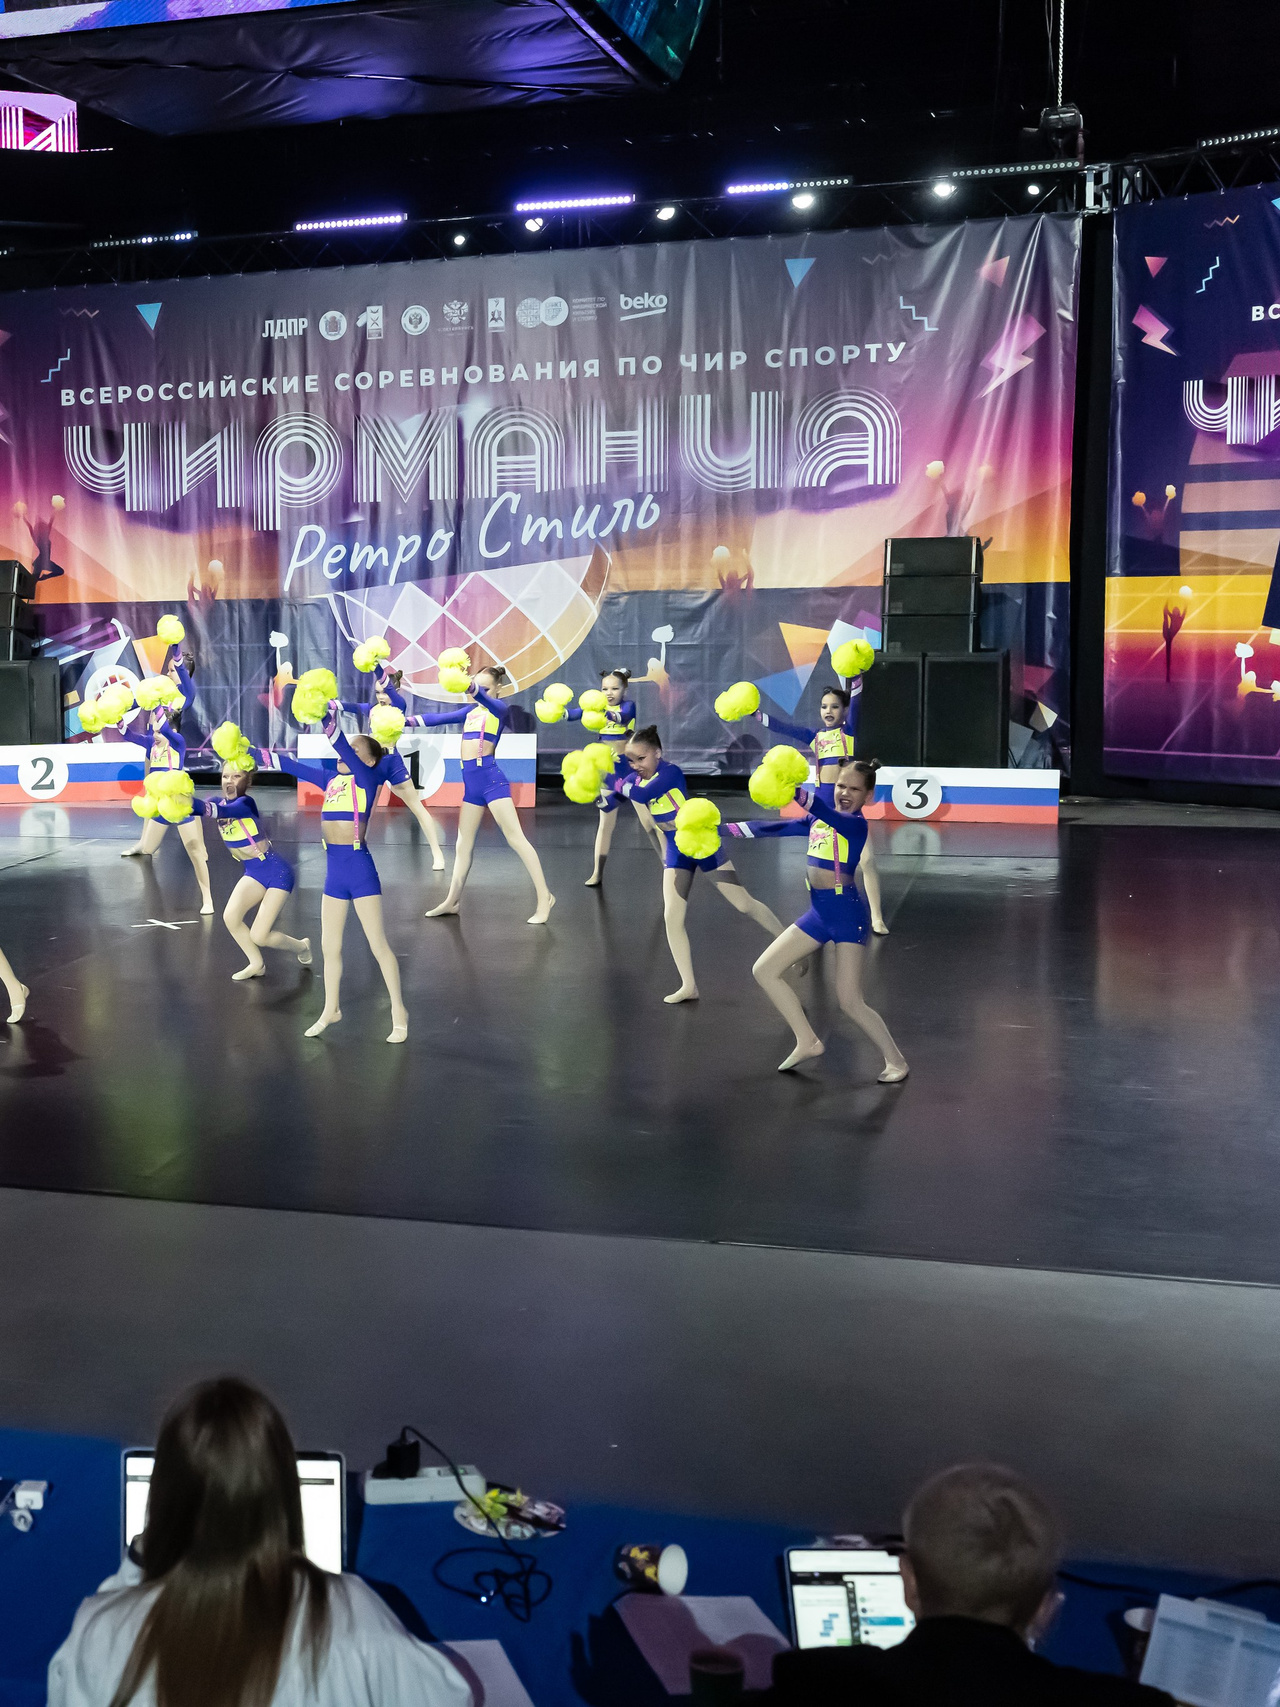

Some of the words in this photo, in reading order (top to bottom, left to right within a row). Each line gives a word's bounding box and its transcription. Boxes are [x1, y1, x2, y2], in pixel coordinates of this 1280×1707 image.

[619, 292, 668, 311] beko
[262, 317, 309, 340] ЛДПР
[61, 374, 320, 406] ВСЕРОССИЙСКИЕ
[334, 358, 601, 391] СОРЕВНОВАНИЯ
[618, 355, 664, 376] ПО
[679, 350, 749, 372] ЧИР
[765, 342, 908, 369] СПОРТУ
[283, 524, 455, 592] Ретро
[478, 491, 661, 559] Стиль
[30, 756, 56, 791] 2
[403, 749, 425, 790] 1
[905, 778, 929, 810] 3
